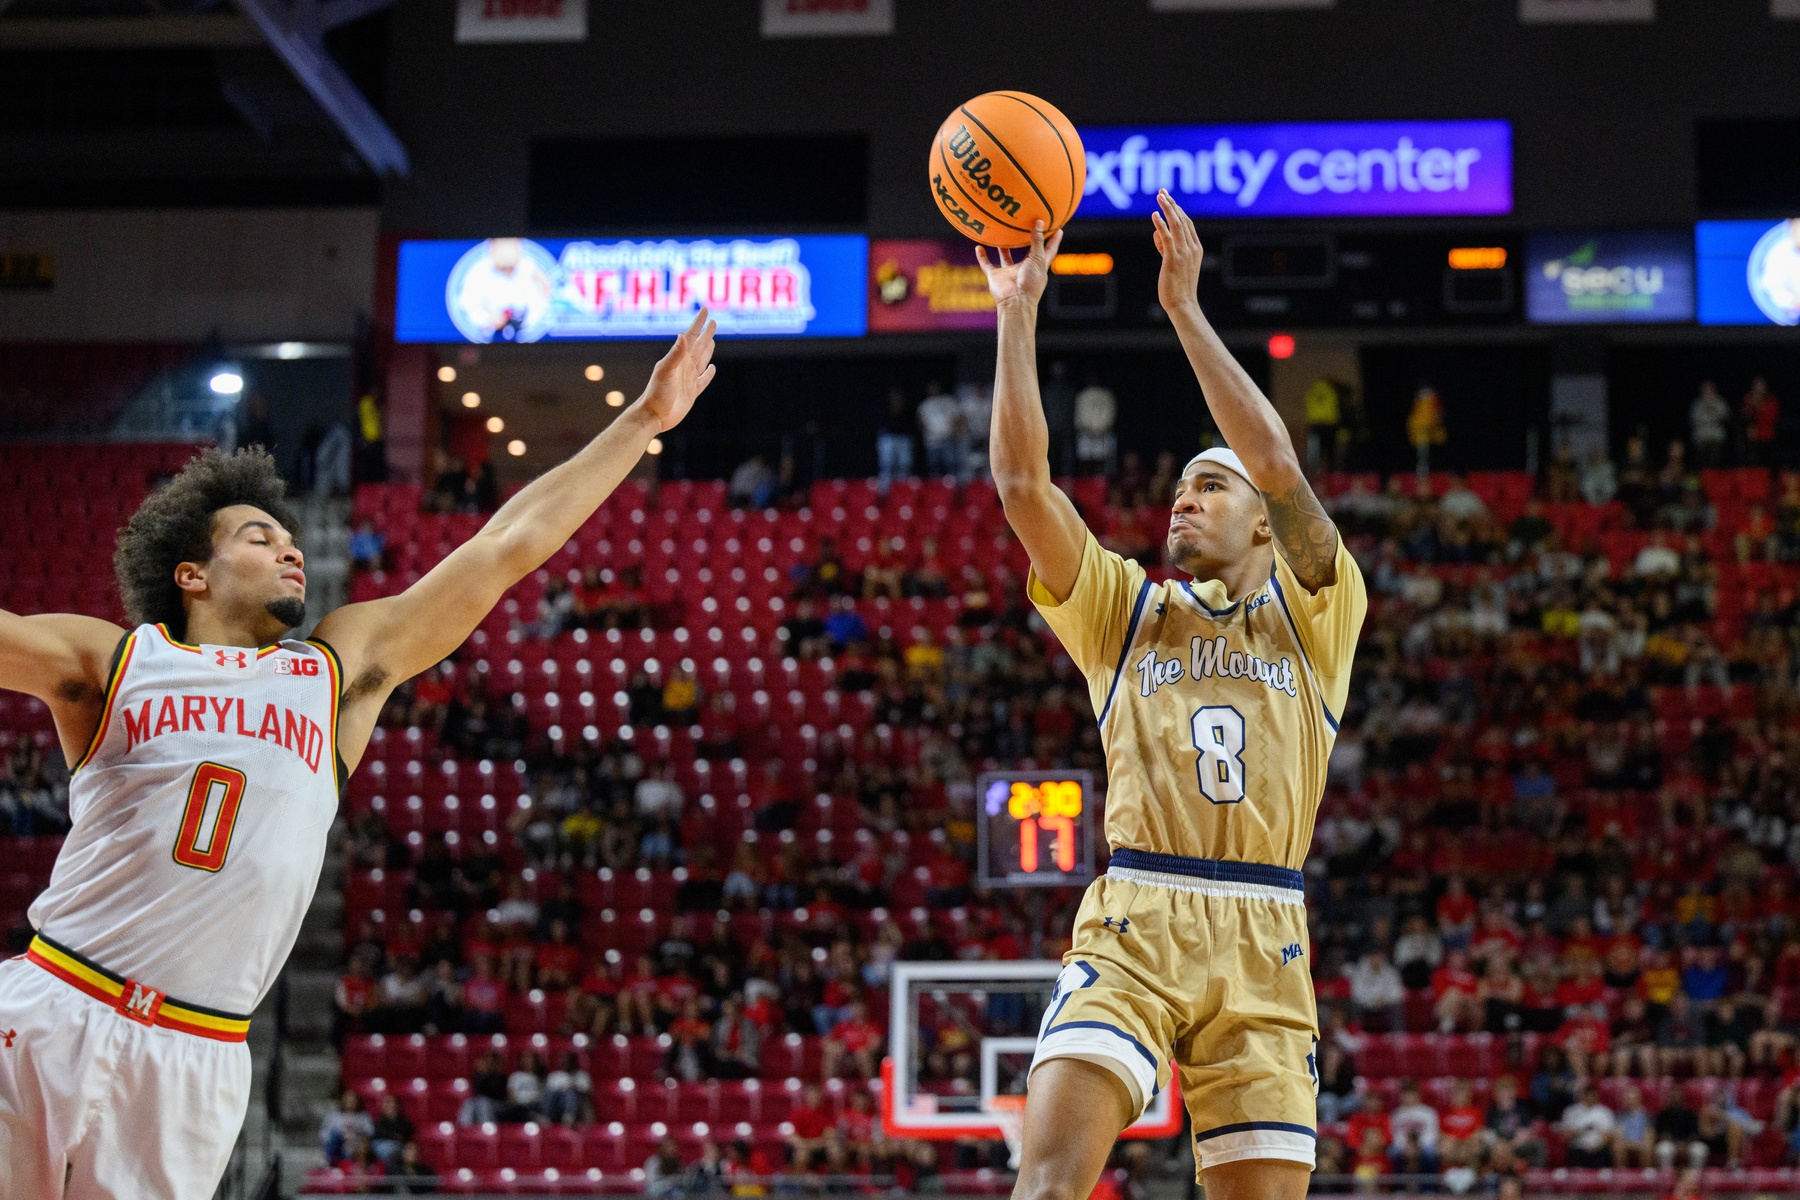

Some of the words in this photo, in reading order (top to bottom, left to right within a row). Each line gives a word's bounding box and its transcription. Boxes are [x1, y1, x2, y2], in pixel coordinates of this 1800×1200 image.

[933, 174, 986, 235] NCAA
[949, 124, 1021, 218] Wilson
[1084, 134, 1279, 209] xfinity
[1283, 136, 1482, 194] center
[1137, 650, 1185, 697] The
[1190, 636, 1297, 698] Mount
[123, 695, 324, 774] MARYLAND
[1190, 704, 1245, 805] 8
[172, 760, 247, 872] 0
[1020, 815, 1075, 873] 17
[126, 983, 158, 1016] M
